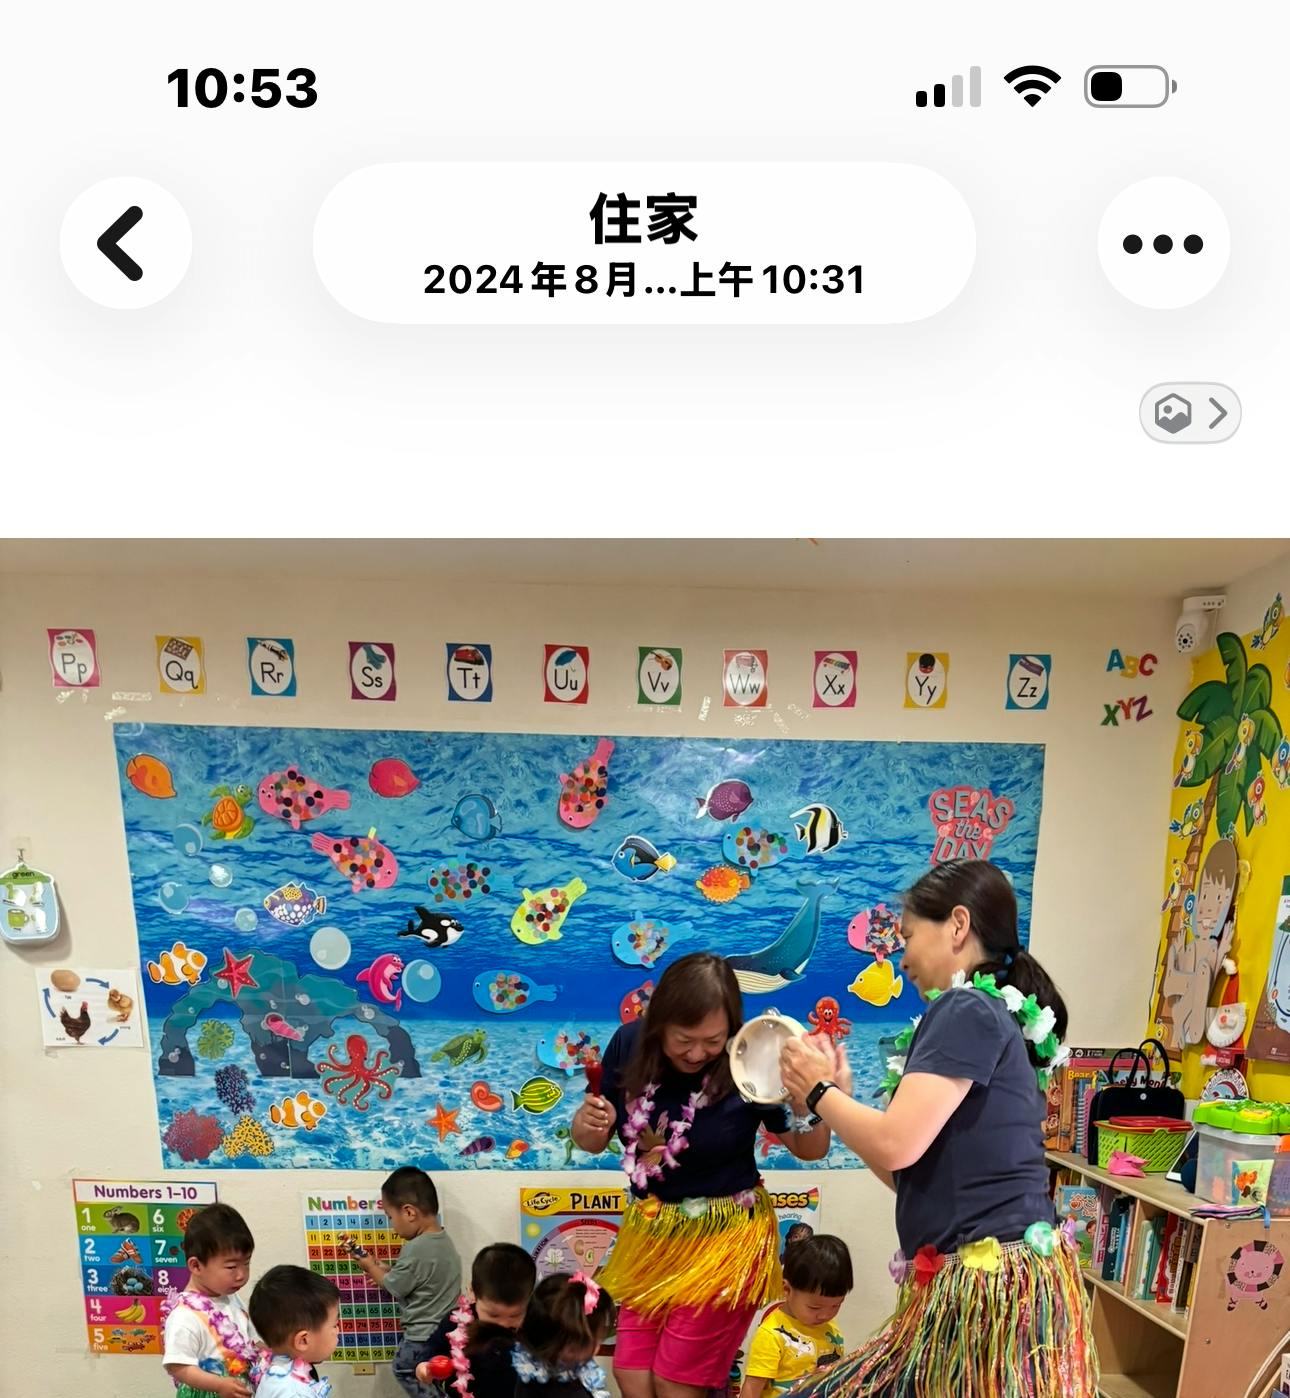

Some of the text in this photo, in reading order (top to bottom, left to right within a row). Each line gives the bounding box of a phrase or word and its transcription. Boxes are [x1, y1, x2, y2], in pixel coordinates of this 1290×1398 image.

[61, 653, 88, 683] Pp
[260, 661, 284, 684] Rr
[1106, 648, 1158, 679] ABC
[165, 660, 198, 690] Qq
[361, 666, 383, 688] Ss
[457, 667, 481, 689] Tt
[554, 668, 578, 691] Uu
[647, 671, 670, 693] Vv
[729, 673, 761, 695] Ww
[822, 675, 846, 696] Xx
[915, 675, 937, 705] Yy
[1017, 677, 1038, 698] Zz
[1100, 695, 1153, 727] XYZ
[934, 791, 1009, 829] SEAS
[955, 819, 982, 842] the
[936, 838, 989, 863] DAY
[94, 1185, 162, 1199] Numbers
[570, 1193, 622, 1210] PLANT
[308, 1195, 384, 1211] Numbers
[81, 1207, 165, 1225] 1 6
[152, 1225, 164, 1233] six
[84, 1238, 167, 1256] 2 7
[87, 1268, 169, 1286] 3 8
[87, 1284, 109, 1292] three
[90, 1298, 102, 1314] 4
[90, 1314, 107, 1322] four
[93, 1328, 105, 1343] 5
[93, 1342, 108, 1351] five
